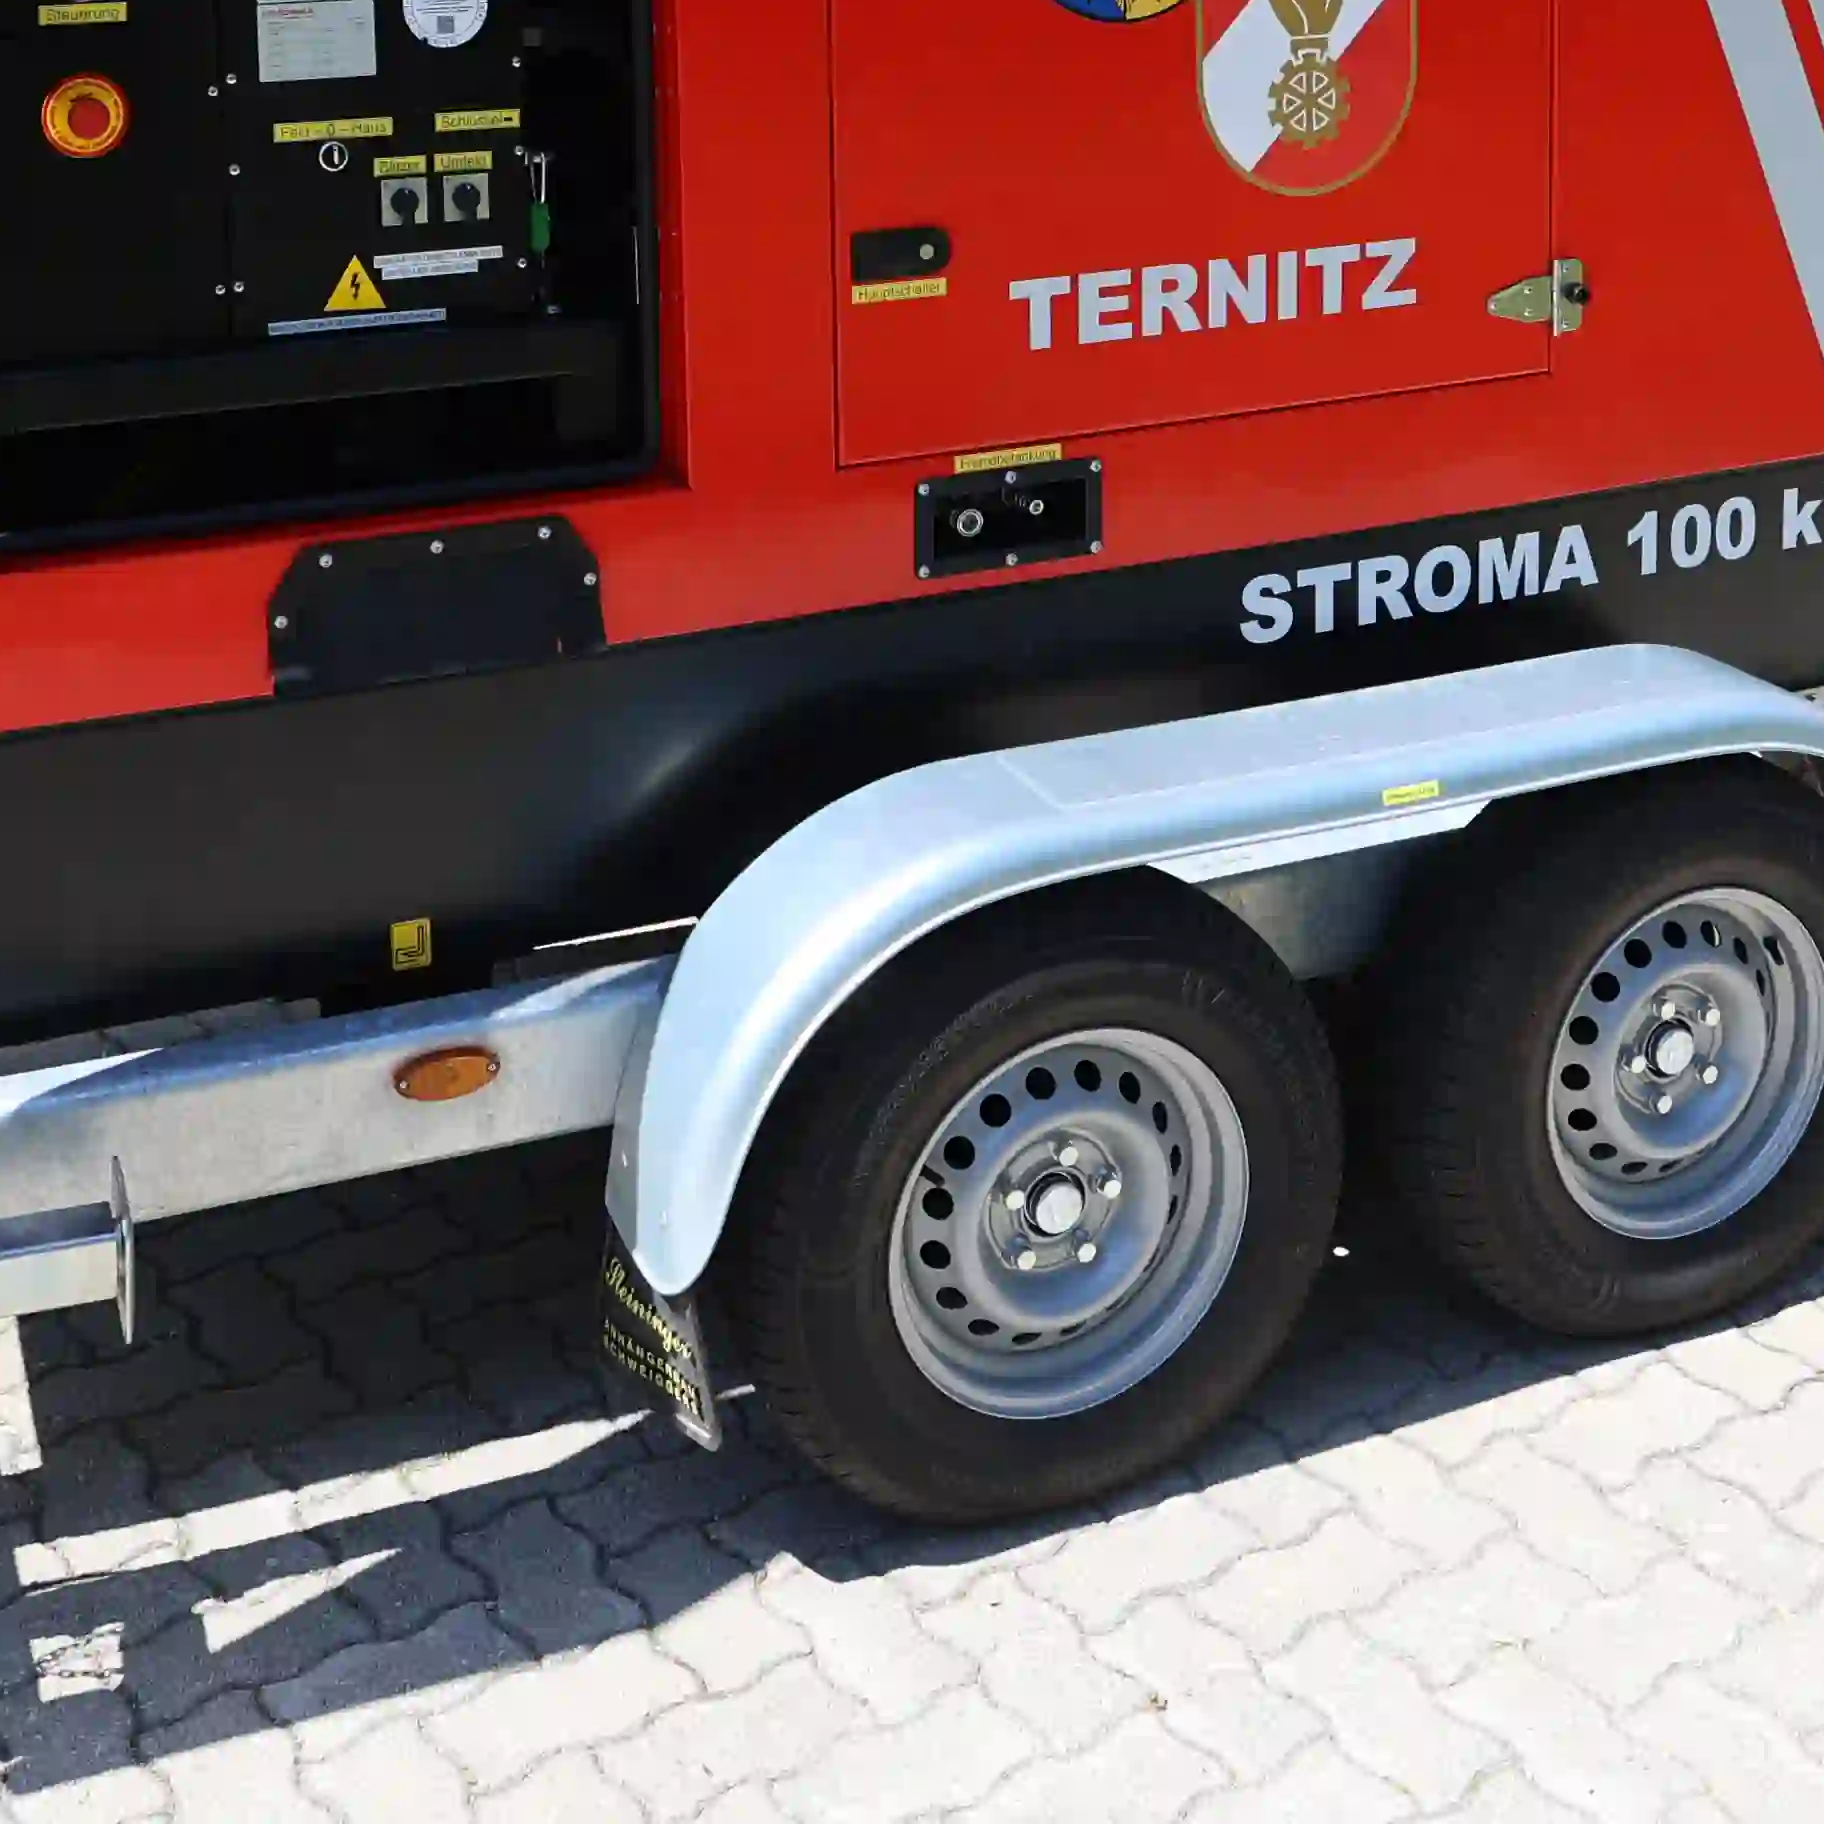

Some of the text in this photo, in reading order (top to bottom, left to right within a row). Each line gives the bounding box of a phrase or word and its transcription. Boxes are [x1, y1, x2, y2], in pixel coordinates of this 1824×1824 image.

[1008, 237, 1417, 351] TERNITZ
[1239, 524, 1600, 644] STROMA
[1627, 496, 1756, 576] 100
